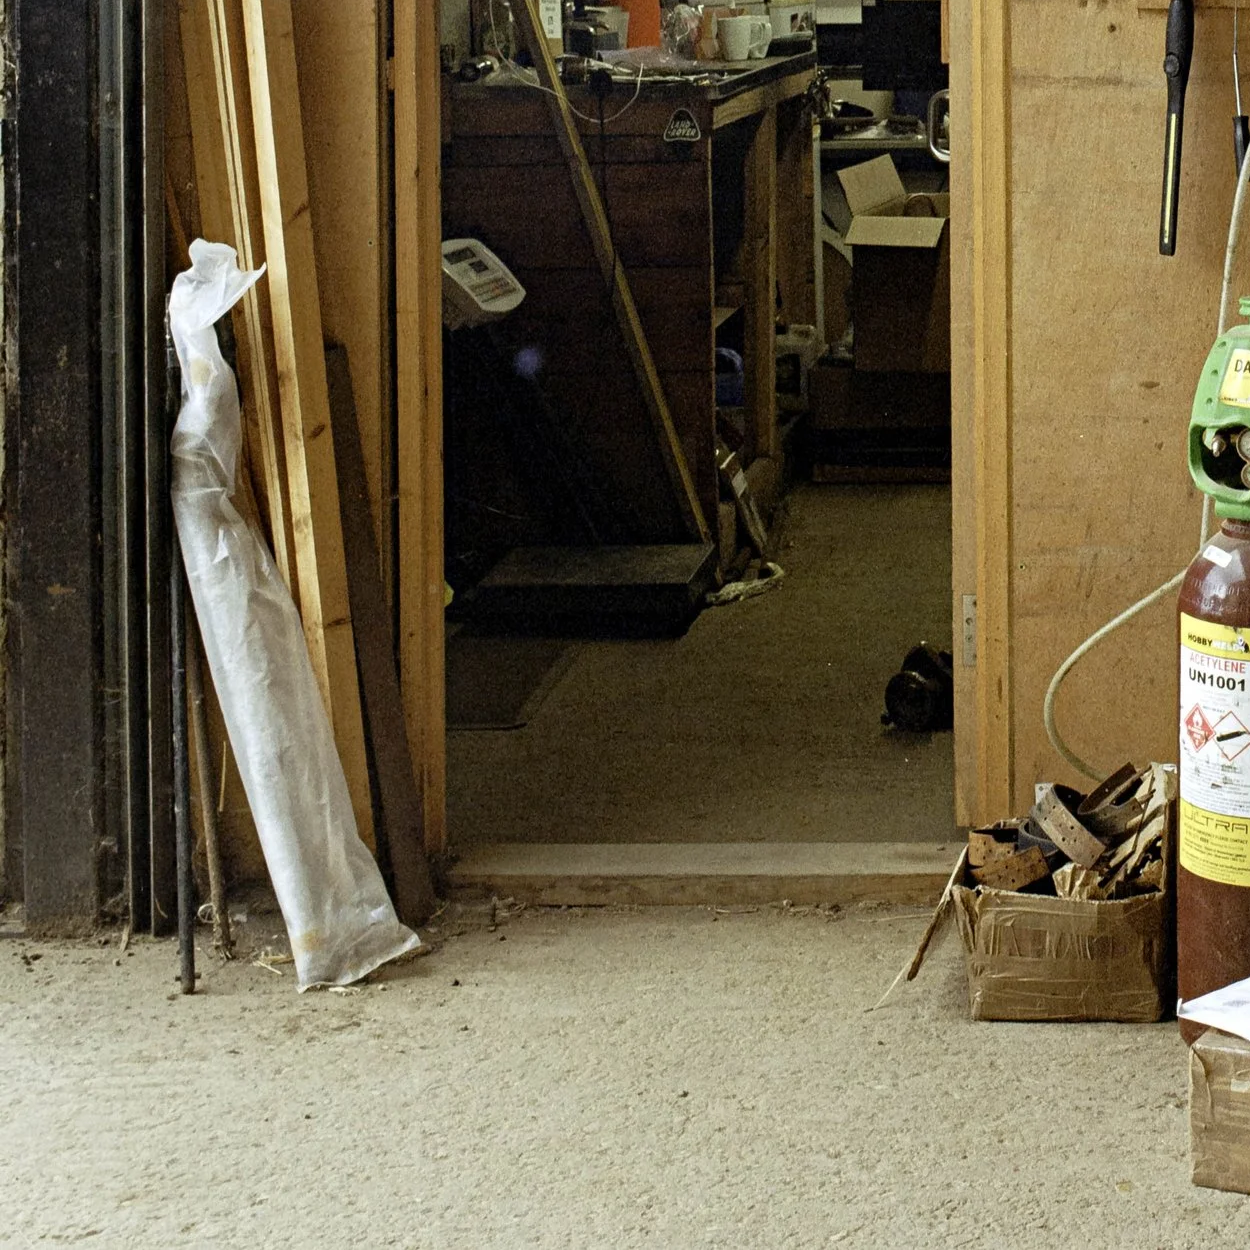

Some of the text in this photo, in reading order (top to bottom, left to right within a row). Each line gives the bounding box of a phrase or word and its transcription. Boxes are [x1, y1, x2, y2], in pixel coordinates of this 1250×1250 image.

[1189, 652, 1247, 675] ACETYLENE
[1188, 667, 1246, 692] UN1001
[1183, 806, 1249, 835] ULTRA
